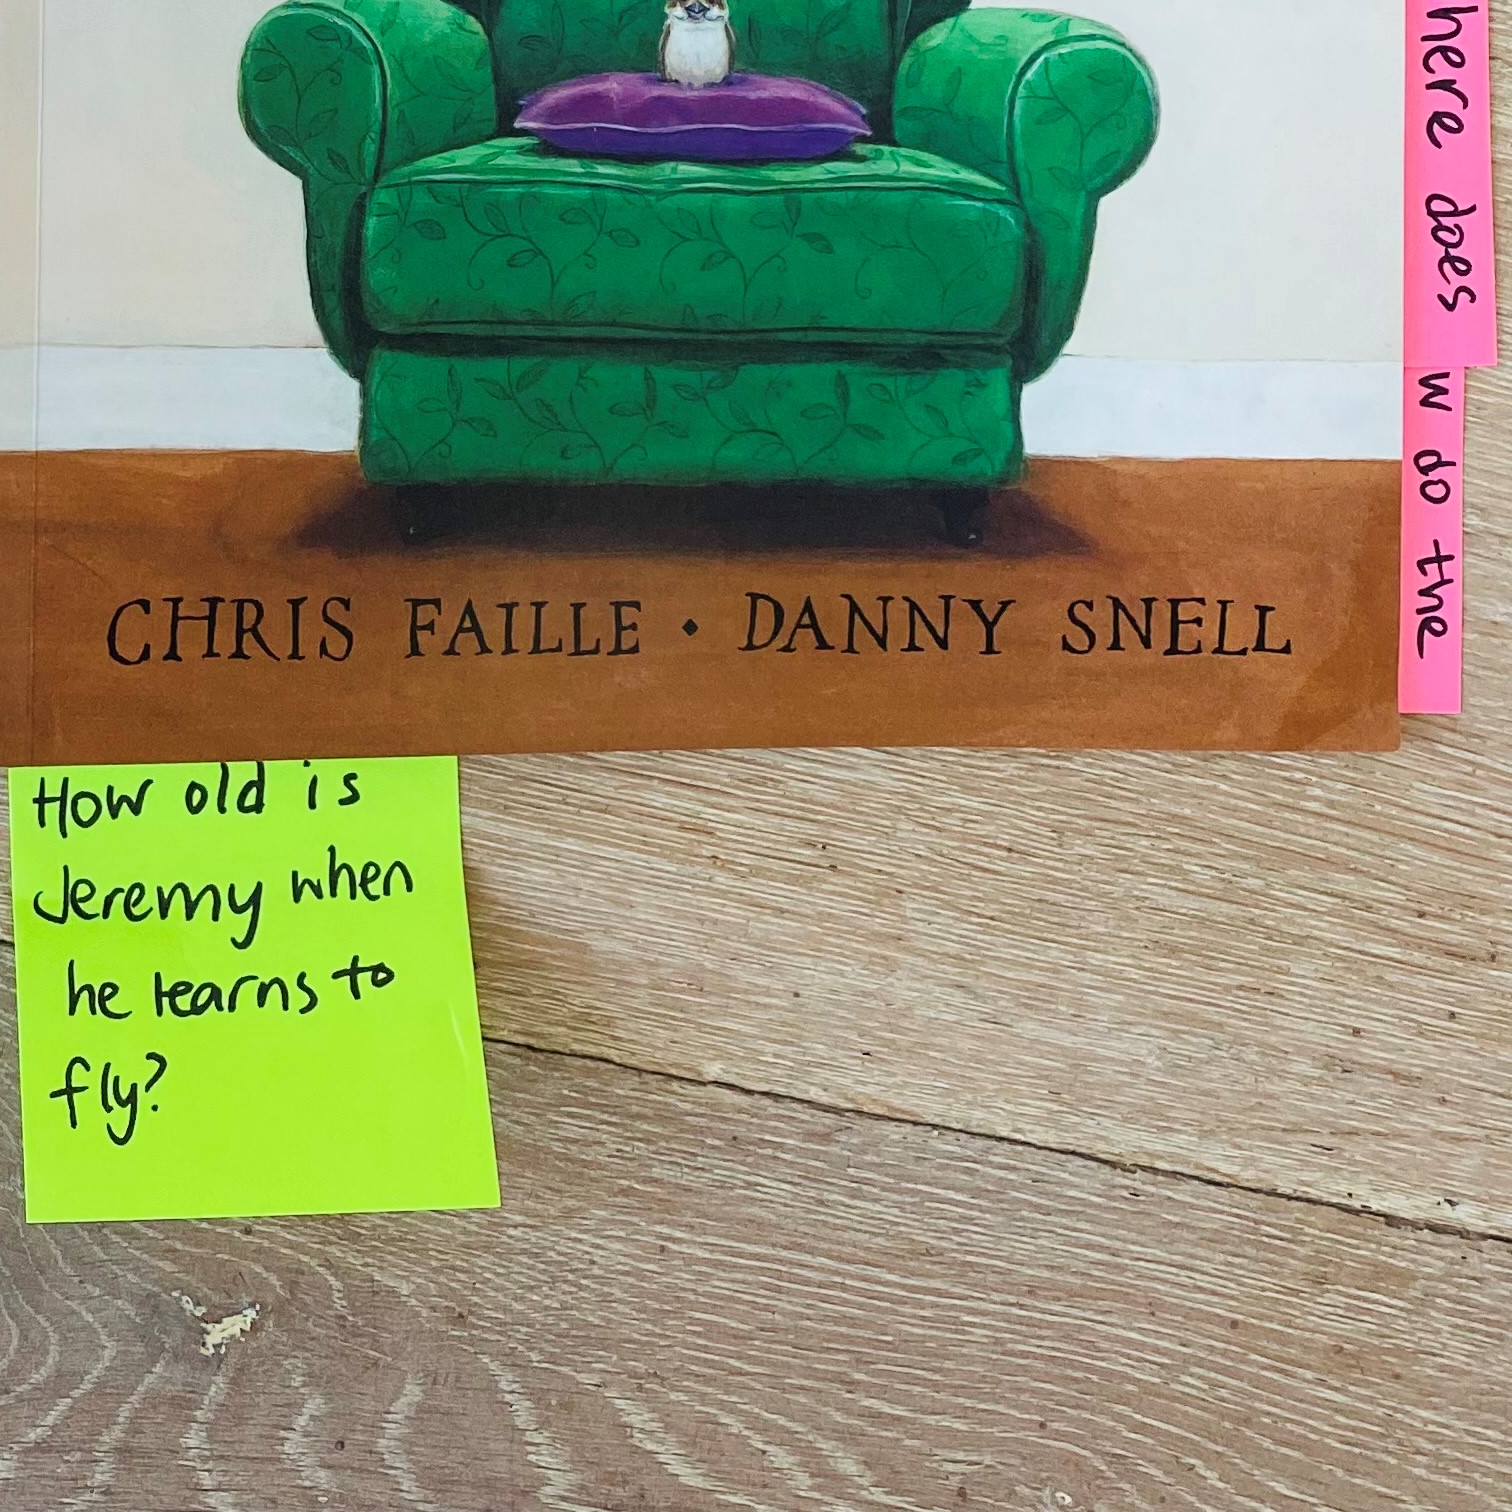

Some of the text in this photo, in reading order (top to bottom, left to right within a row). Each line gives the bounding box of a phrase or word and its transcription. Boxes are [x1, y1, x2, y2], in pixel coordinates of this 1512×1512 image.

[1424, 193, 1477, 312] does
[1414, 450, 1456, 504] do
[106, 591, 1292, 665] CHRIS FAILLE DANNY SNELL
[1416, 539, 1455, 659] the
[33, 760, 360, 837] How old is
[34, 845, 413, 949] Jeremy when
[68, 960, 132, 1019] he
[332, 955, 395, 1000] to
[50, 1052, 167, 1146] fly?
